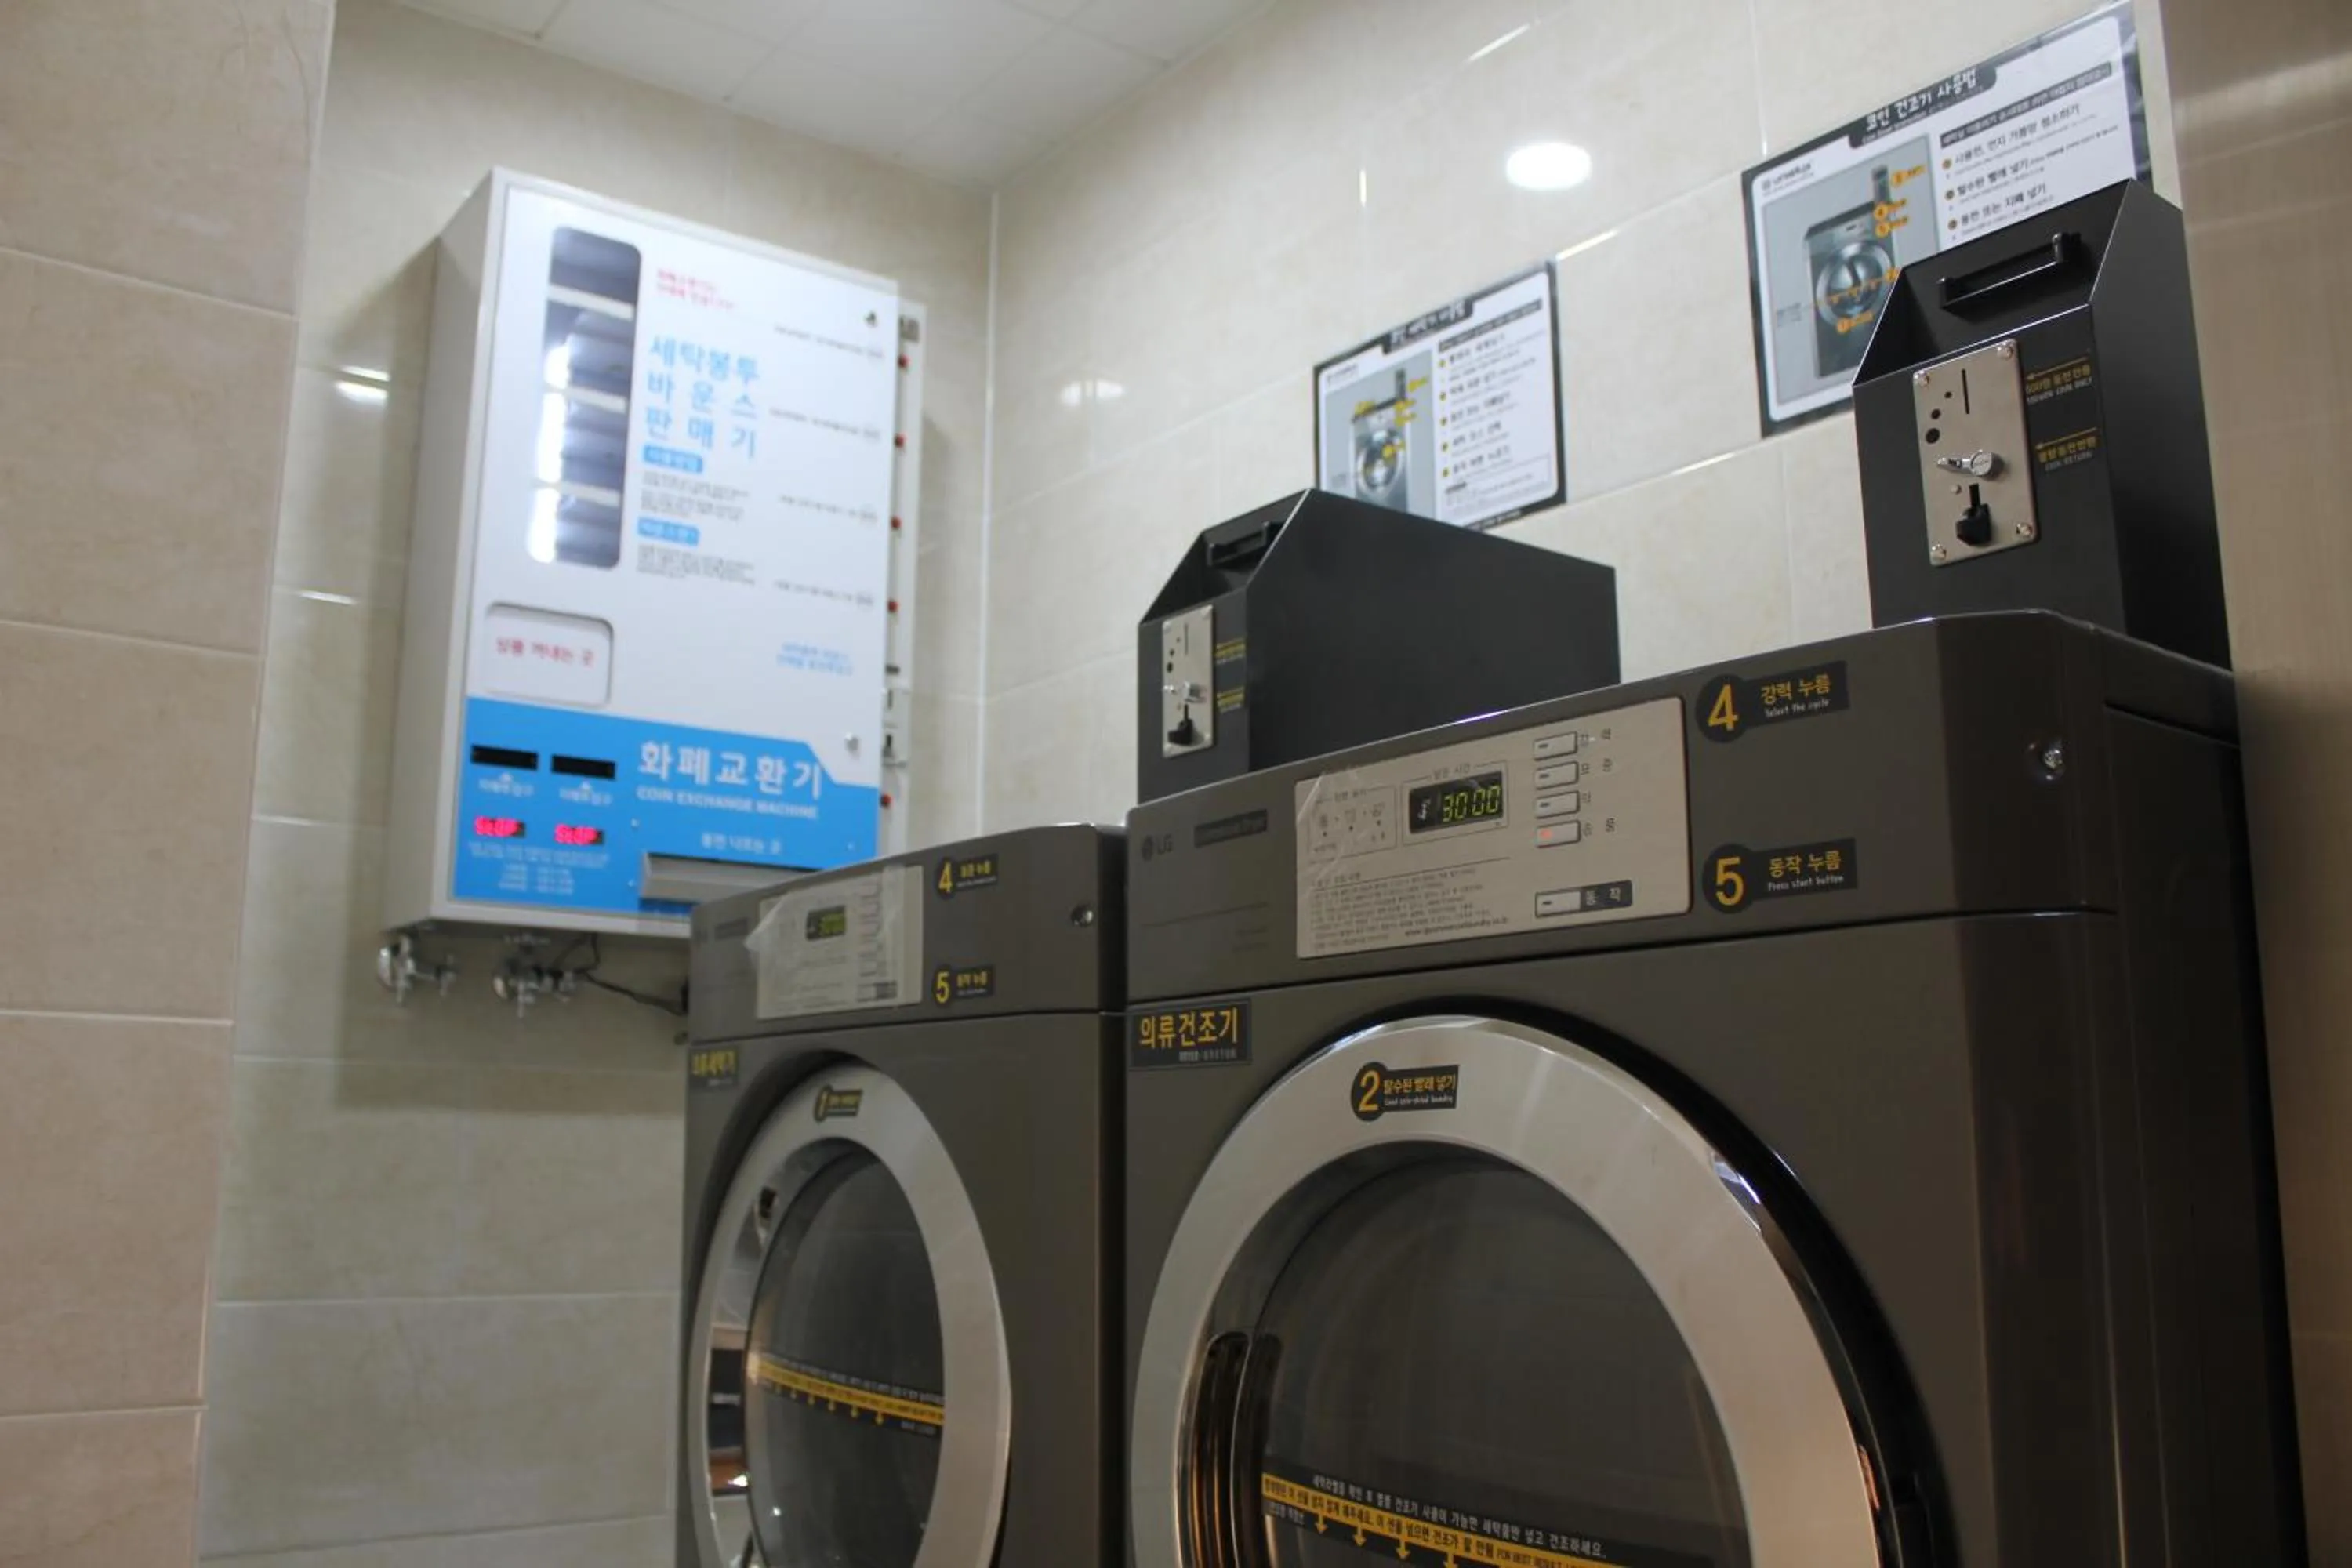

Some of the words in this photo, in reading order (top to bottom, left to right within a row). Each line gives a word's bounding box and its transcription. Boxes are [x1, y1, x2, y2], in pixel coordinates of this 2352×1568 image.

[1894, 92, 1933, 118] 건조기
[1938, 67, 1976, 96] 사용법
[649, 335, 760, 384] 세탁봉투
[1761, 681, 1793, 705] 강력
[1798, 672, 1831, 697] 누름
[1708, 683, 1739, 731] 4
[1766, 706, 1789, 718] Select
[638, 741, 822, 800] 화폐교환기
[636, 786, 674, 803] COIN
[677, 790, 753, 812] EXCHANGE
[756, 798, 818, 819] MACHINE
[1156, 833, 1174, 855] LG
[938, 862, 953, 893] 4
[1715, 855, 1744, 906] 5
[1769, 855, 1802, 878] 동작
[1808, 850, 1841, 872] 누름
[1768, 882, 1790, 892] Press
[1791, 879, 1813, 888] start
[1816, 875, 1844, 886] button
[936, 971, 949, 1004] 5
[1139, 1006, 1238, 1049] 의류건조기
[1359, 1069, 1381, 1112] 2
[1414, 1076, 1434, 1093] 빨래
[1437, 1073, 1456, 1091] 넣기
[1451, 1510, 1478, 1531] 가능한
[1483, 1518, 1519, 1541] 세탁물만
[1525, 1528, 1544, 1544] 넣고
